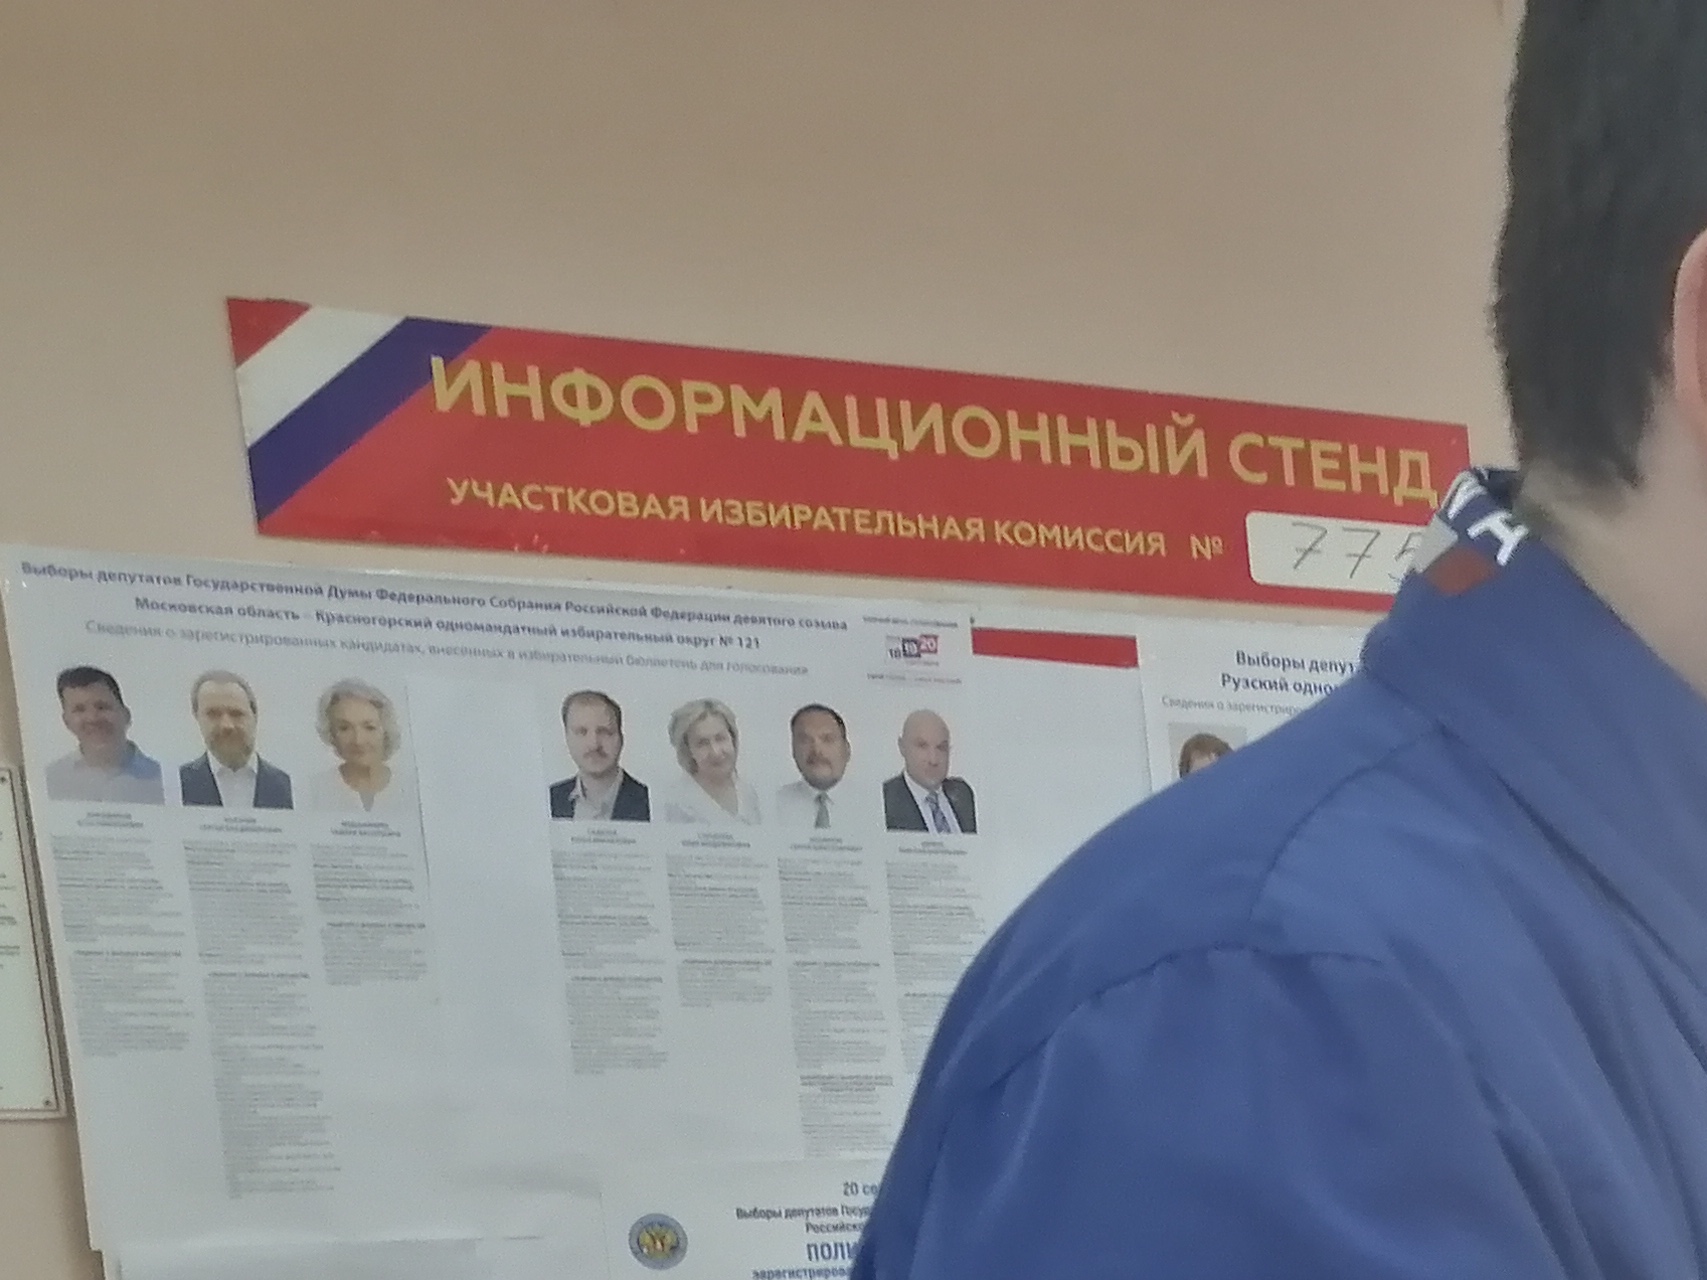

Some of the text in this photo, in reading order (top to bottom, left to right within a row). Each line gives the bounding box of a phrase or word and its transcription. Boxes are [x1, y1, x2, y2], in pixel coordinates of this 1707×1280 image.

[430, 354, 1438, 509] ИНФОРМАЦИОННЫЙ СТЕНД
[446, 477, 1223, 560] УЧАСТКОВАЯ ИЗБИРАТЕЛЬНАЯ КОМИССИЯ №
[21, 561, 93, 580] Выборы
[97, 570, 182, 587] депутатов
[186, 574, 323, 597] Государственной
[327, 584, 372, 600] Думы
[376, 588, 487, 608] Федерального
[489, 596, 561, 612] Собрания
[565, 601, 647, 618] Российской
[651, 608, 730, 624] Федерации
[733, 614, 795, 629] девятого
[799, 618, 848, 631] созыва
[135, 596, 233, 616] Московская
[238, 606, 300, 621] область
[315, 610, 433, 629] Красногорский
[436, 618, 558, 638] одномандатный
[560, 627, 674, 645] избирательный
[676, 635, 715, 649] округ
[1235, 650, 1305, 671] Выборы
[1220, 672, 1289, 692] Рузский
[843, 1181, 859, 1196] 20
[736, 1207, 782, 1220] Выборы
